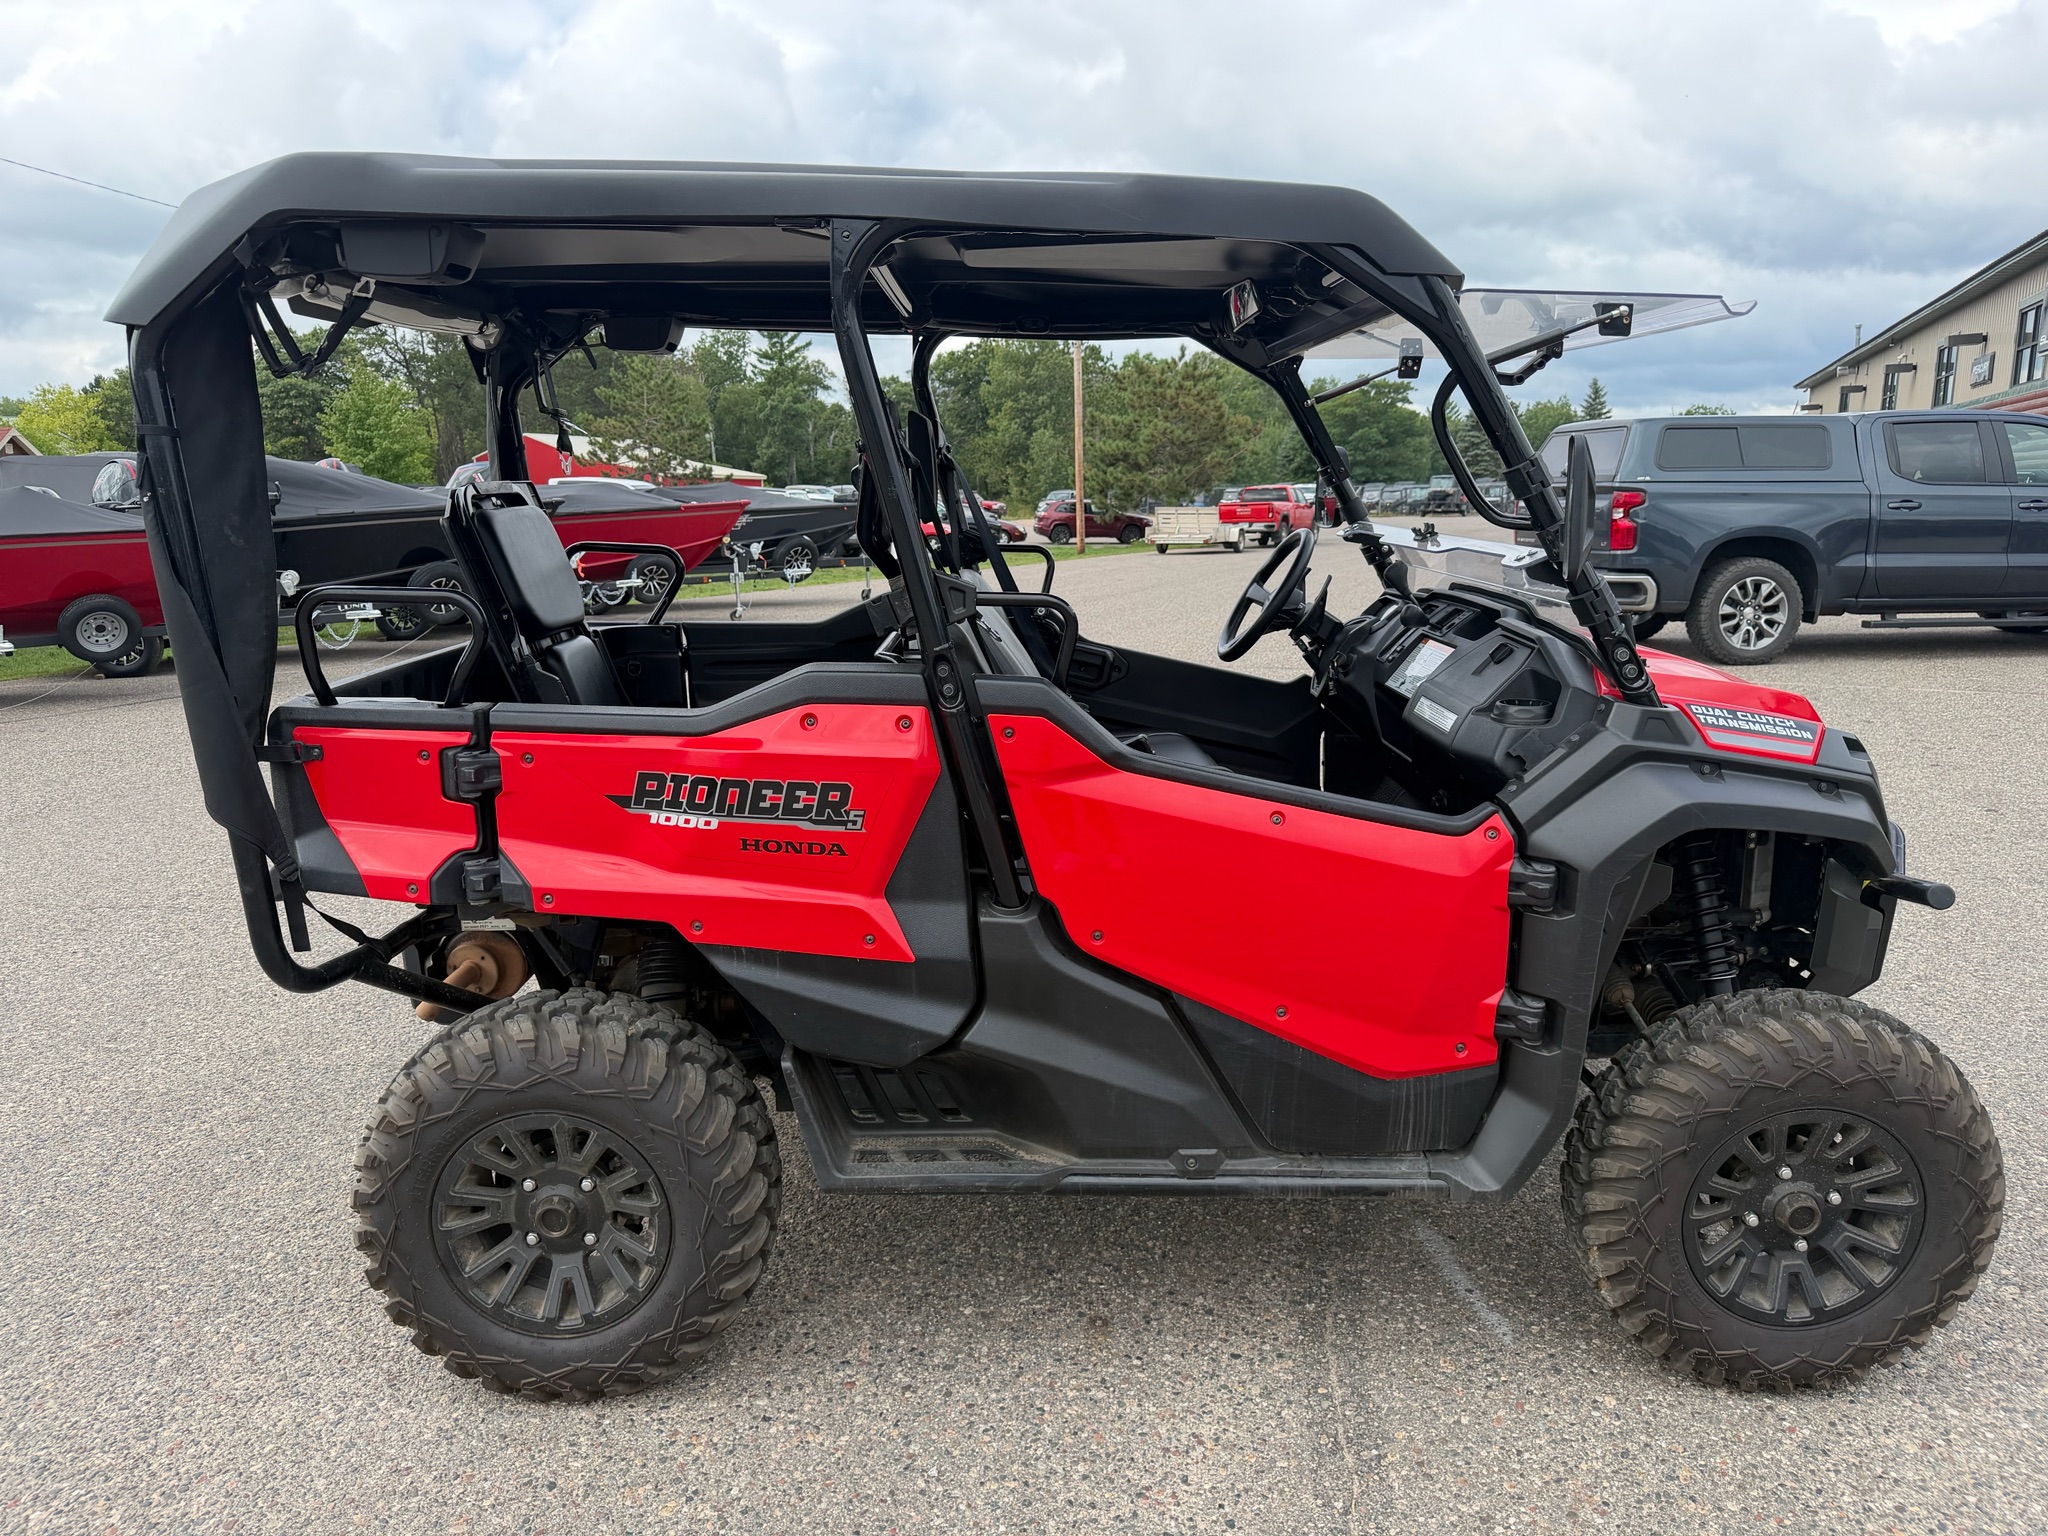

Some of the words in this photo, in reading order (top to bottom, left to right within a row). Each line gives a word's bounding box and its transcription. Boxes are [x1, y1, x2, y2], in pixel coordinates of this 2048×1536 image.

[1690, 704, 1733, 719] DUAL
[1736, 711, 1797, 729] CLUTCH
[1696, 714, 1813, 739] TRANSMISSION
[631, 770, 853, 820] PIONEER
[648, 811, 719, 830] 1000
[739, 837, 849, 857] HONDA
